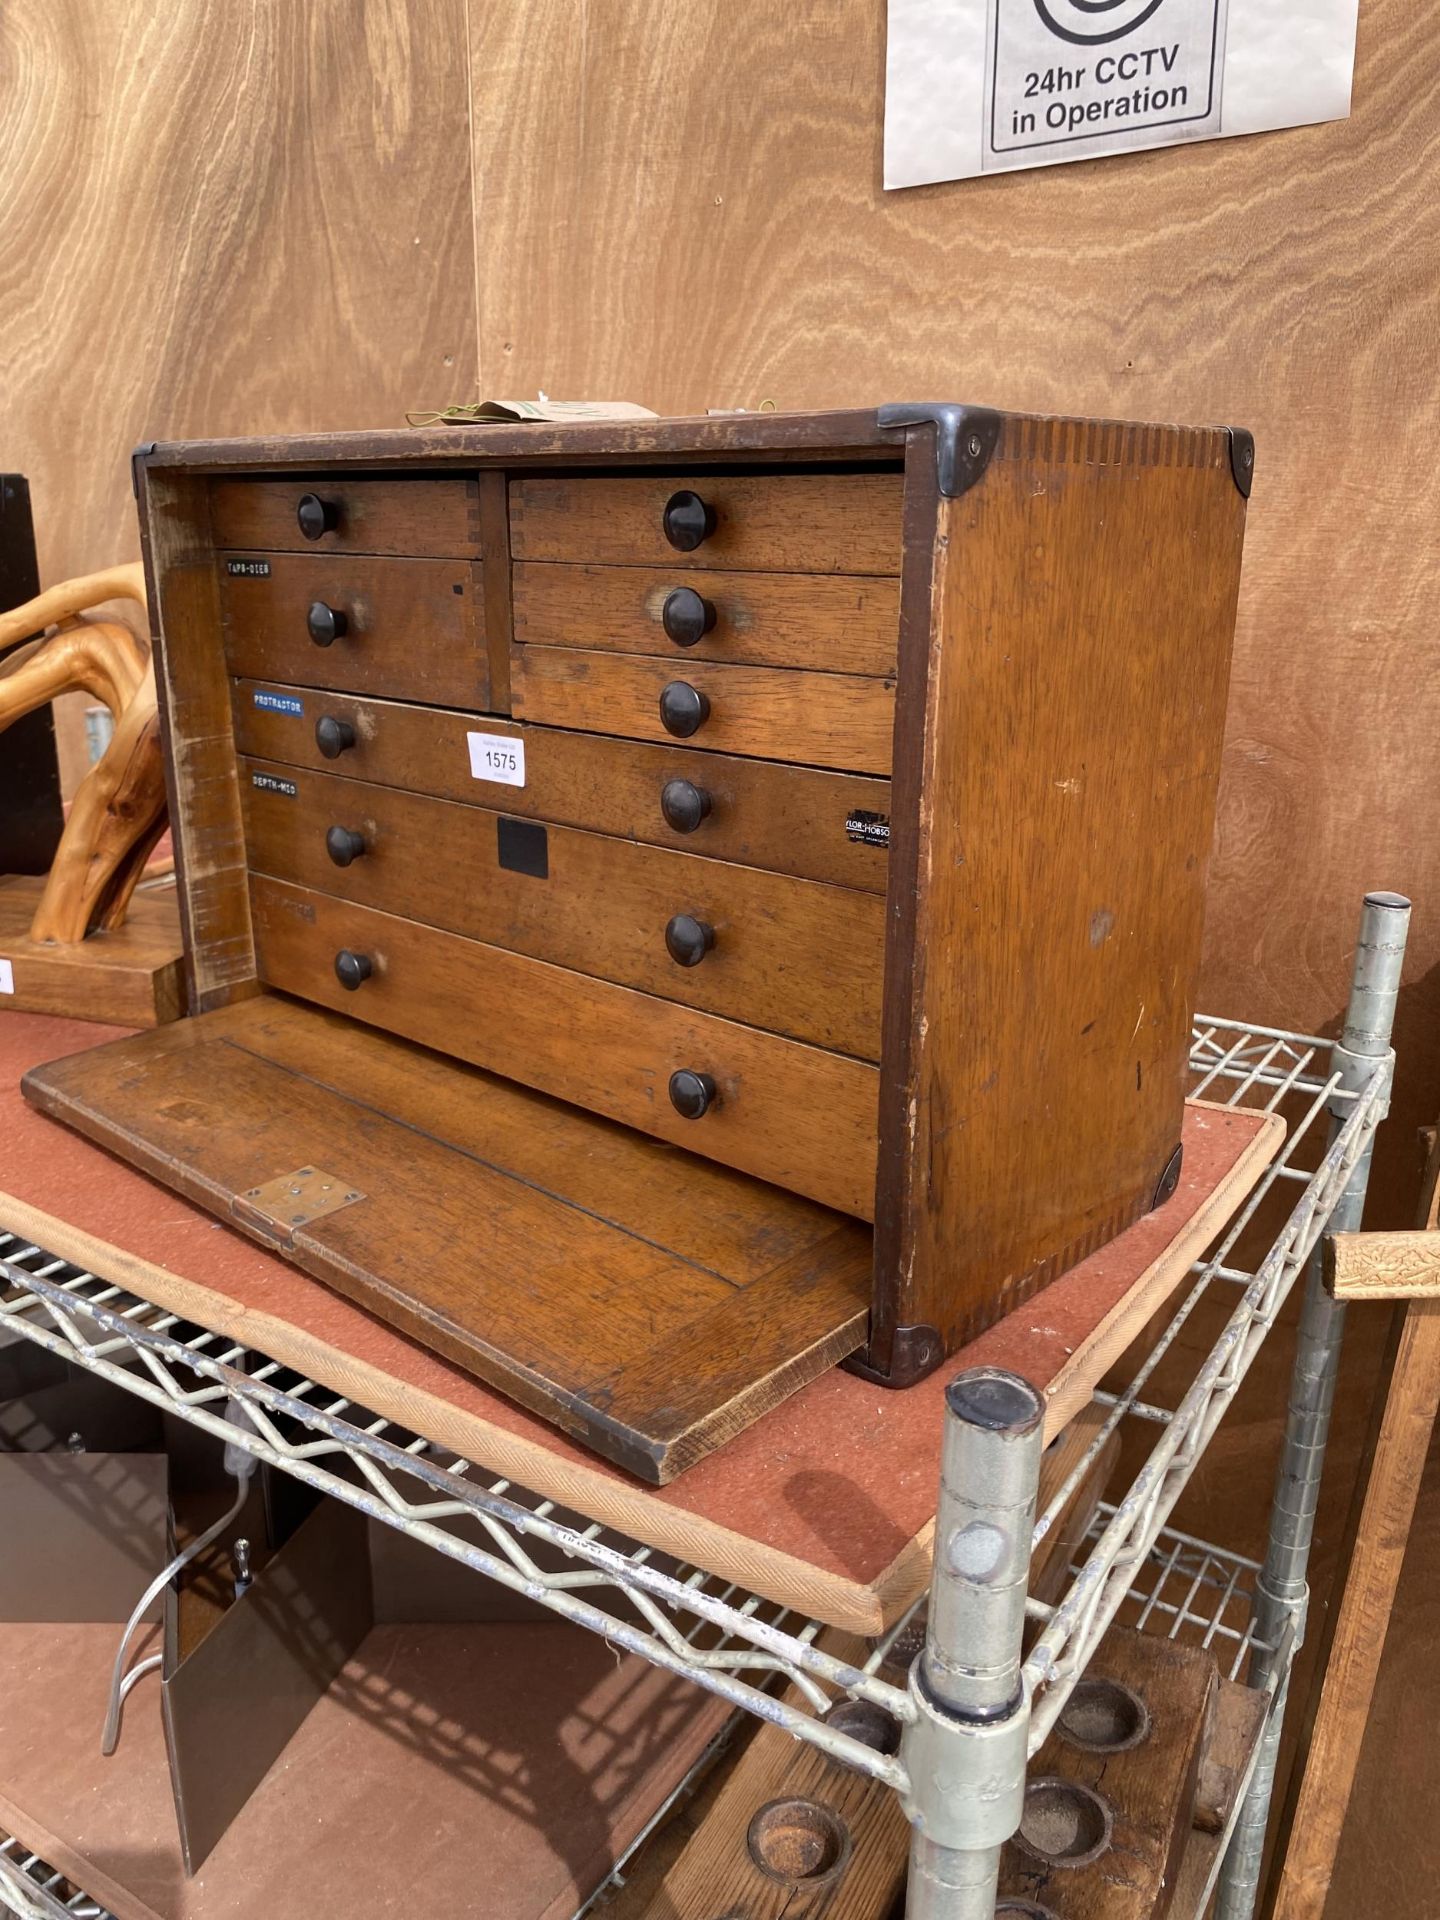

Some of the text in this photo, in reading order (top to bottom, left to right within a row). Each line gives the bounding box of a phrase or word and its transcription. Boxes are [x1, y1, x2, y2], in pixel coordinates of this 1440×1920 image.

[1024, 44, 1180, 99] 24hr CCTV
[1012, 84, 1188, 135] in Operation
[254, 694, 301, 713] PROTRACTOR
[486, 751, 516, 771] 1575
